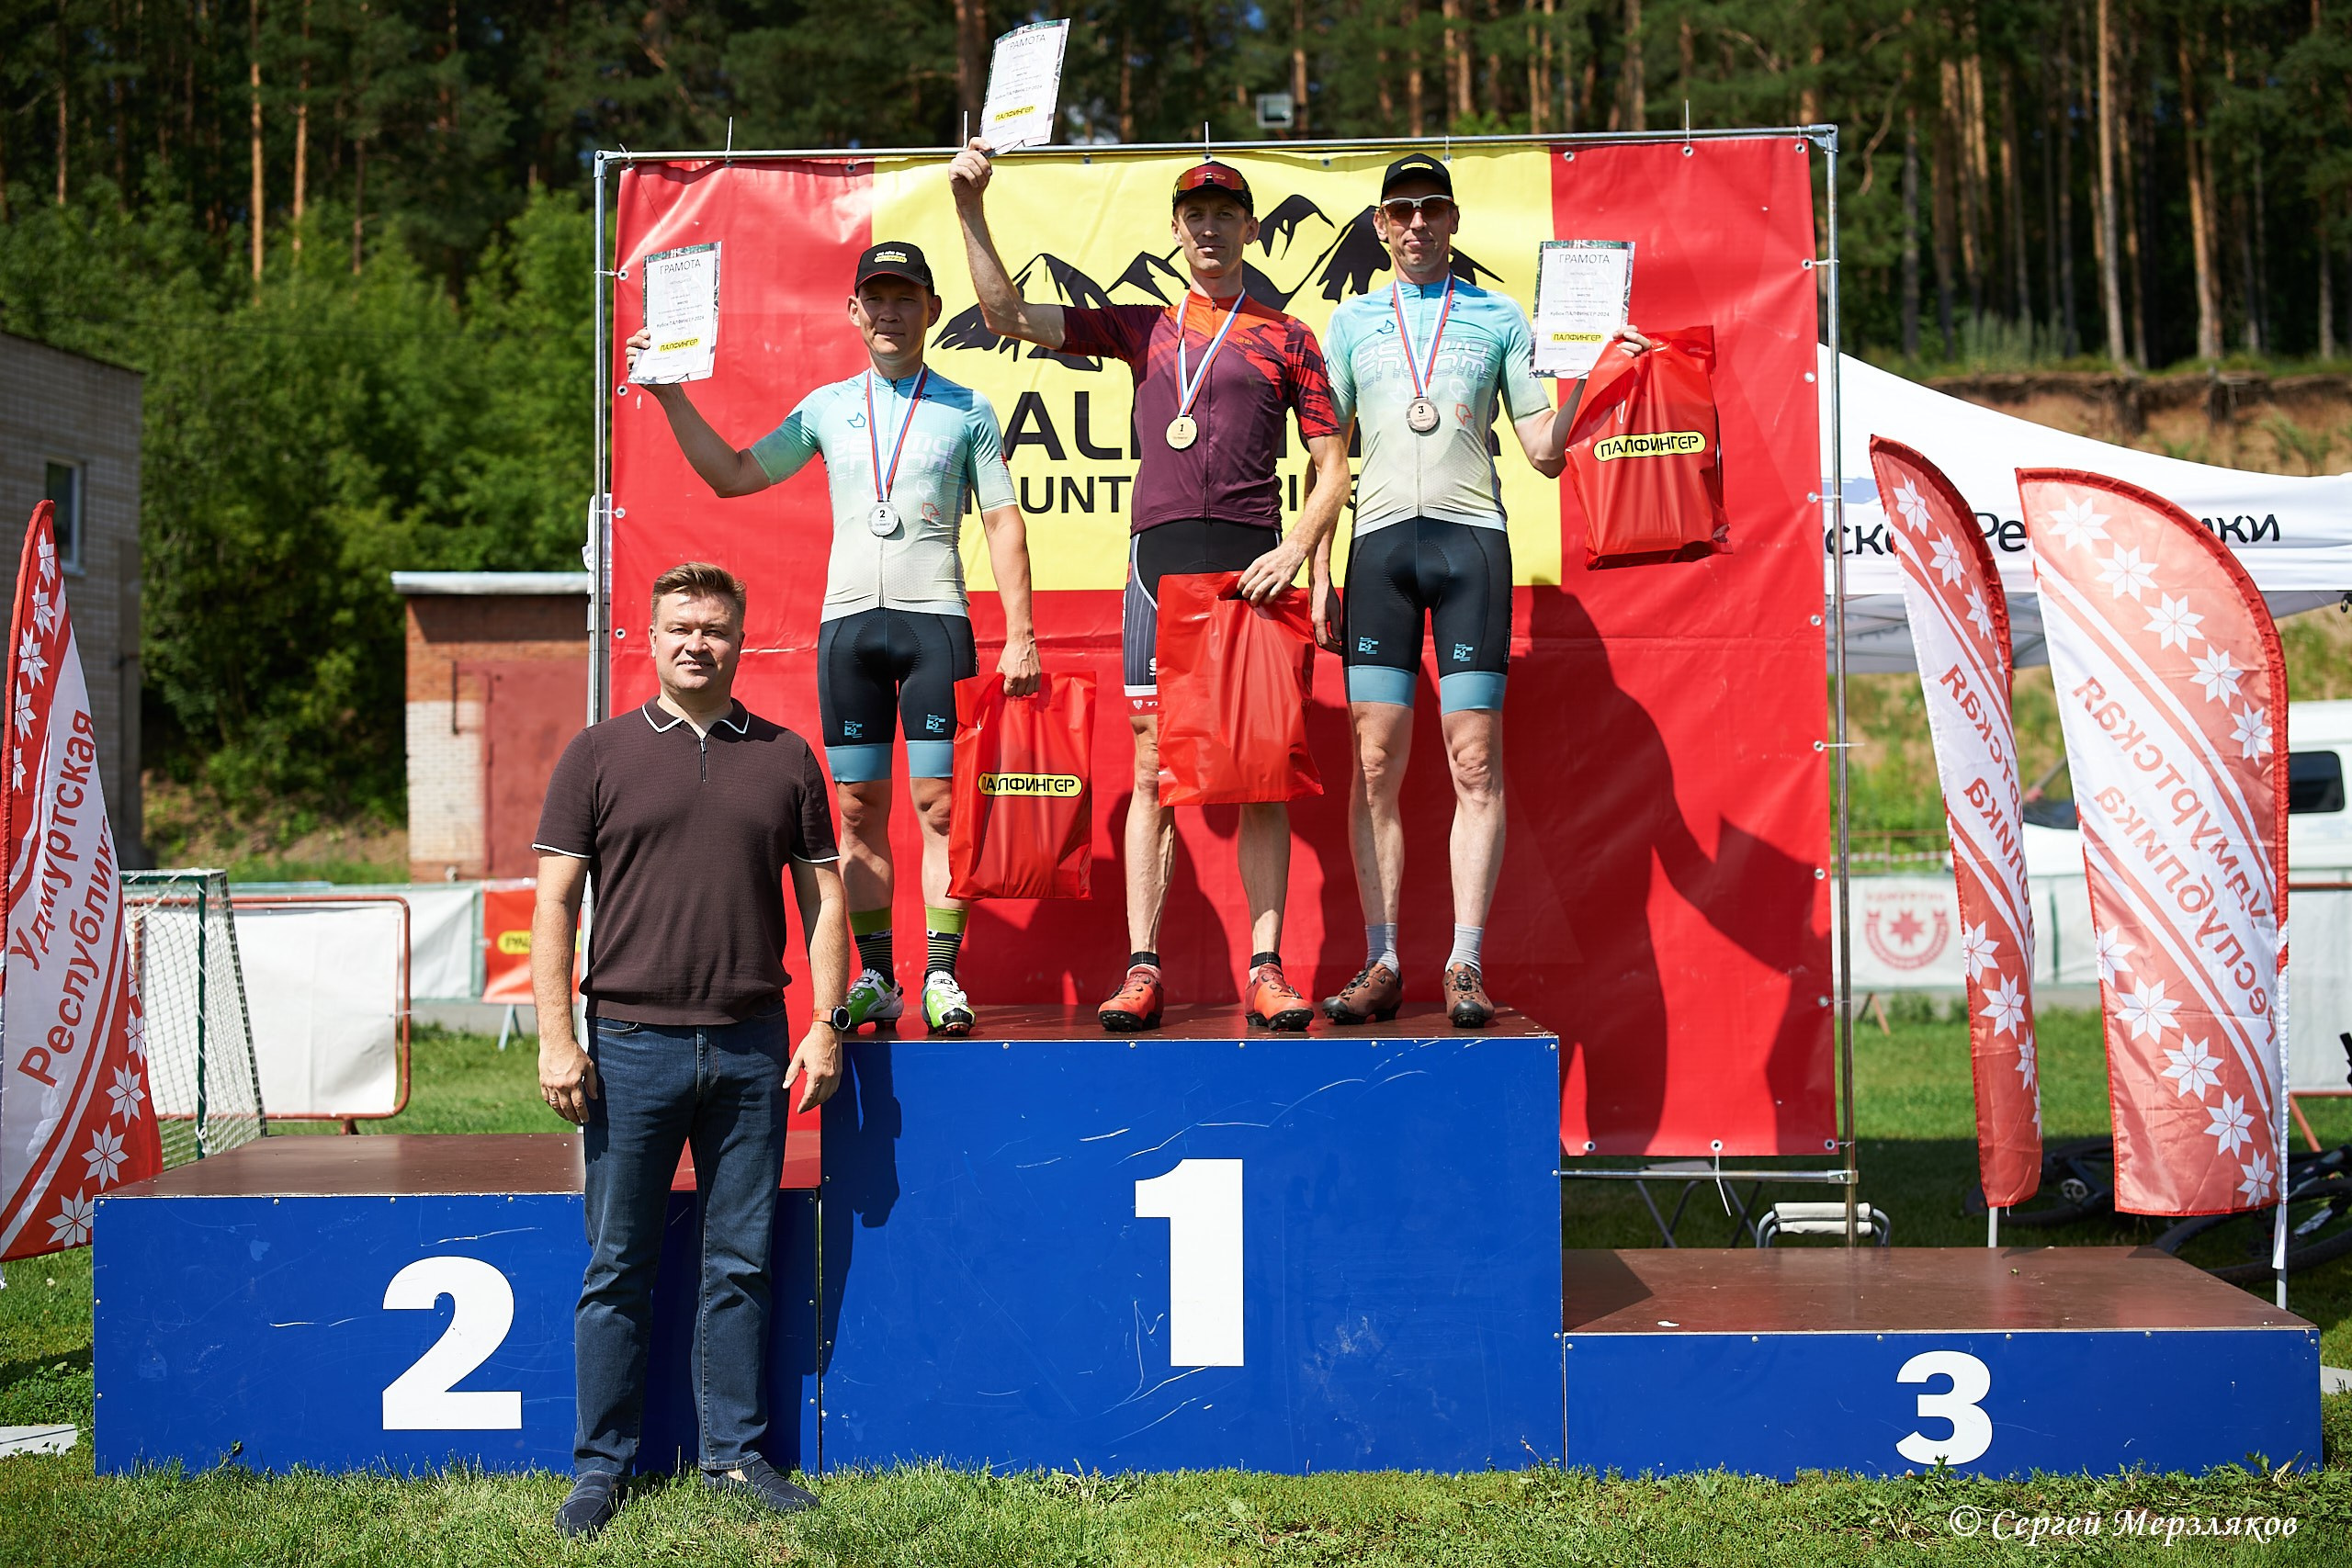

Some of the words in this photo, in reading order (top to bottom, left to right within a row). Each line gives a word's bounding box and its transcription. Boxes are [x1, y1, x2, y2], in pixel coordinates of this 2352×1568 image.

[1006, 34, 1046, 51] ГРАМОТА
[995, 106, 1034, 121] ПАЛФИНГЕР
[660, 258, 701, 275] ГРАМОТА
[1559, 254, 1611, 264] ГРАМОТА
[660, 338, 698, 352] ПАЛФИНГЕР
[1553, 333, 1601, 342] ПАЛФИНГЕР
[1418, 405, 1424, 414] 3
[1180, 423, 1184, 432] 1
[1600, 435, 1700, 457] ПАЛФИНГЕР
[879, 510, 886, 518] 2
[9, 710, 95, 971] Удмуртская
[17, 815, 113, 1089] Республик
[1135, 1158, 1244, 1367] 1
[382, 1256, 522, 1431] 2
[1895, 1349, 1993, 1465] 3
